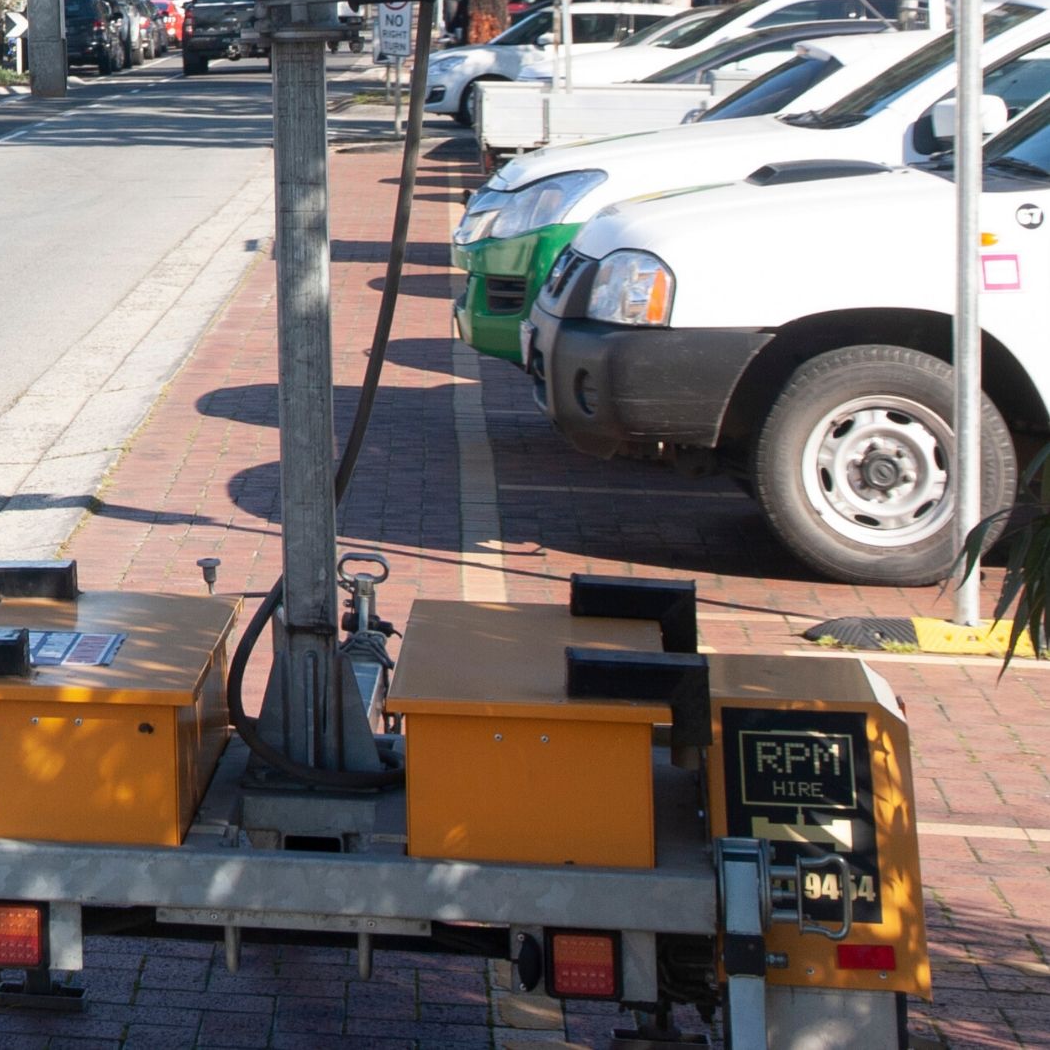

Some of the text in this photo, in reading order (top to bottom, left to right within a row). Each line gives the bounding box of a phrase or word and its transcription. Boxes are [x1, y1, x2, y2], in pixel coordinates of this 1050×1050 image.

[385, 14, 404, 27] NO
[382, 30, 407, 39] RIGHT
[383, 41, 406, 51] TURN
[755, 740, 841, 775] RPM
[773, 781, 823, 798] HIRE
